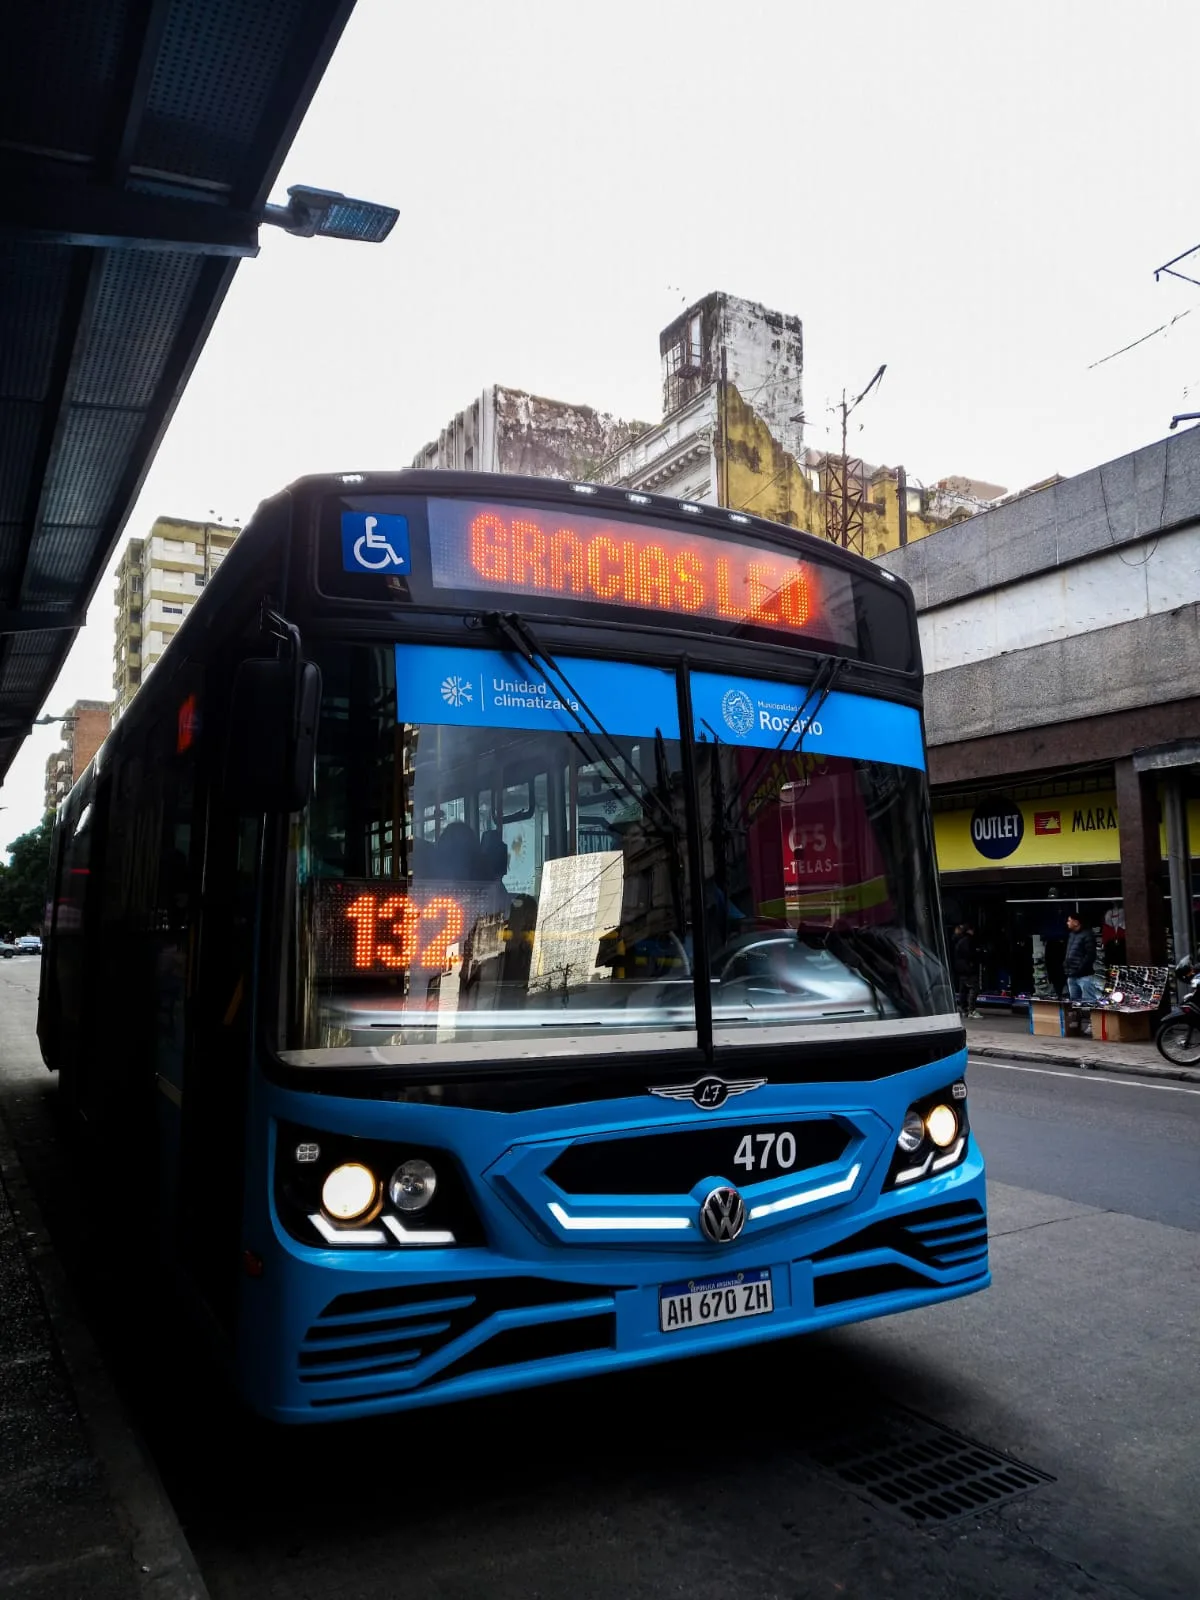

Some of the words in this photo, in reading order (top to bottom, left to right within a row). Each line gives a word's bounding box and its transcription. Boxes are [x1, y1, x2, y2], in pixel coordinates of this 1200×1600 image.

[469, 510, 706, 611] GRACIAS
[716, 557, 809, 626] LEO
[493, 678, 547, 695] Unidad
[759, 710, 823, 736] Rosario
[974, 814, 1019, 841] OUTLET
[347, 895, 464, 968] 132
[733, 1131, 797, 1171] 470
[667, 1297, 693, 1326] AH
[699, 1289, 737, 1319] 670
[743, 1283, 769, 1312] ZH
